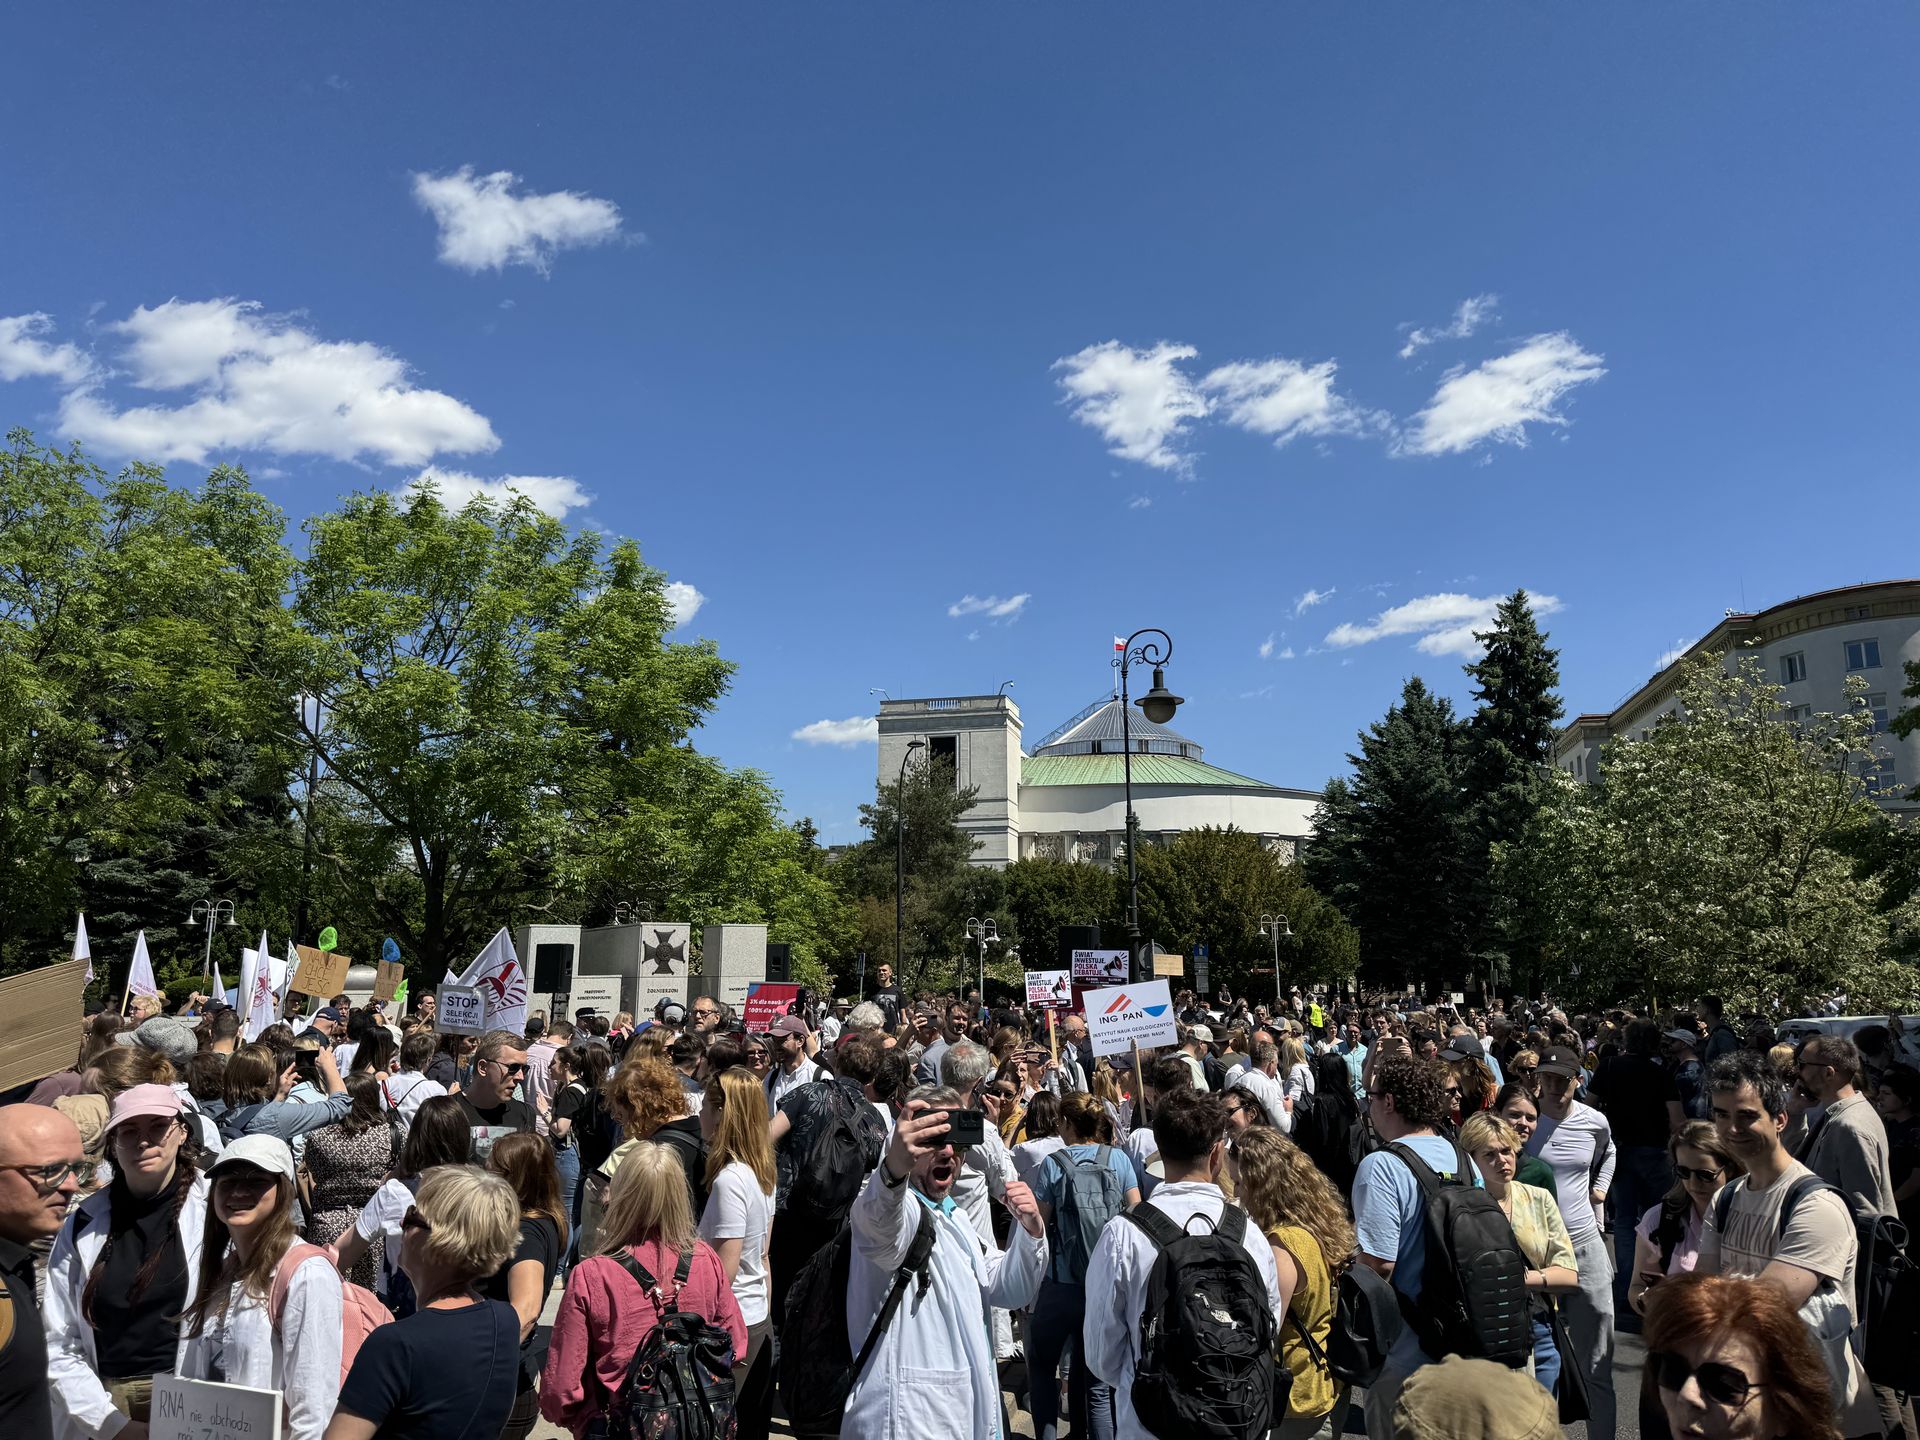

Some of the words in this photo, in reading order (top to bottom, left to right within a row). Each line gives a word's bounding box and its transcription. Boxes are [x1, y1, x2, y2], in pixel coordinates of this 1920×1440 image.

[1028, 985, 1047, 993] POLSKA
[447, 996, 479, 1008] STOP
[446, 1010, 479, 1019] SELEKCJI
[1099, 1015, 1118, 1024] ING
[1122, 1011, 1143, 1020] PAN
[443, 1017, 480, 1026] NEGATYWNEJ
[1092, 1030, 1116, 1038] INSTYTUT
[1131, 1022, 1174, 1032] GEOLOGICZNYCH
[1101, 1037, 1125, 1045] POLSKIEJ
[159, 1389, 185, 1420] RNA
[190, 1408, 202, 1423] nie
[210, 1402, 252, 1433] obchodzi
